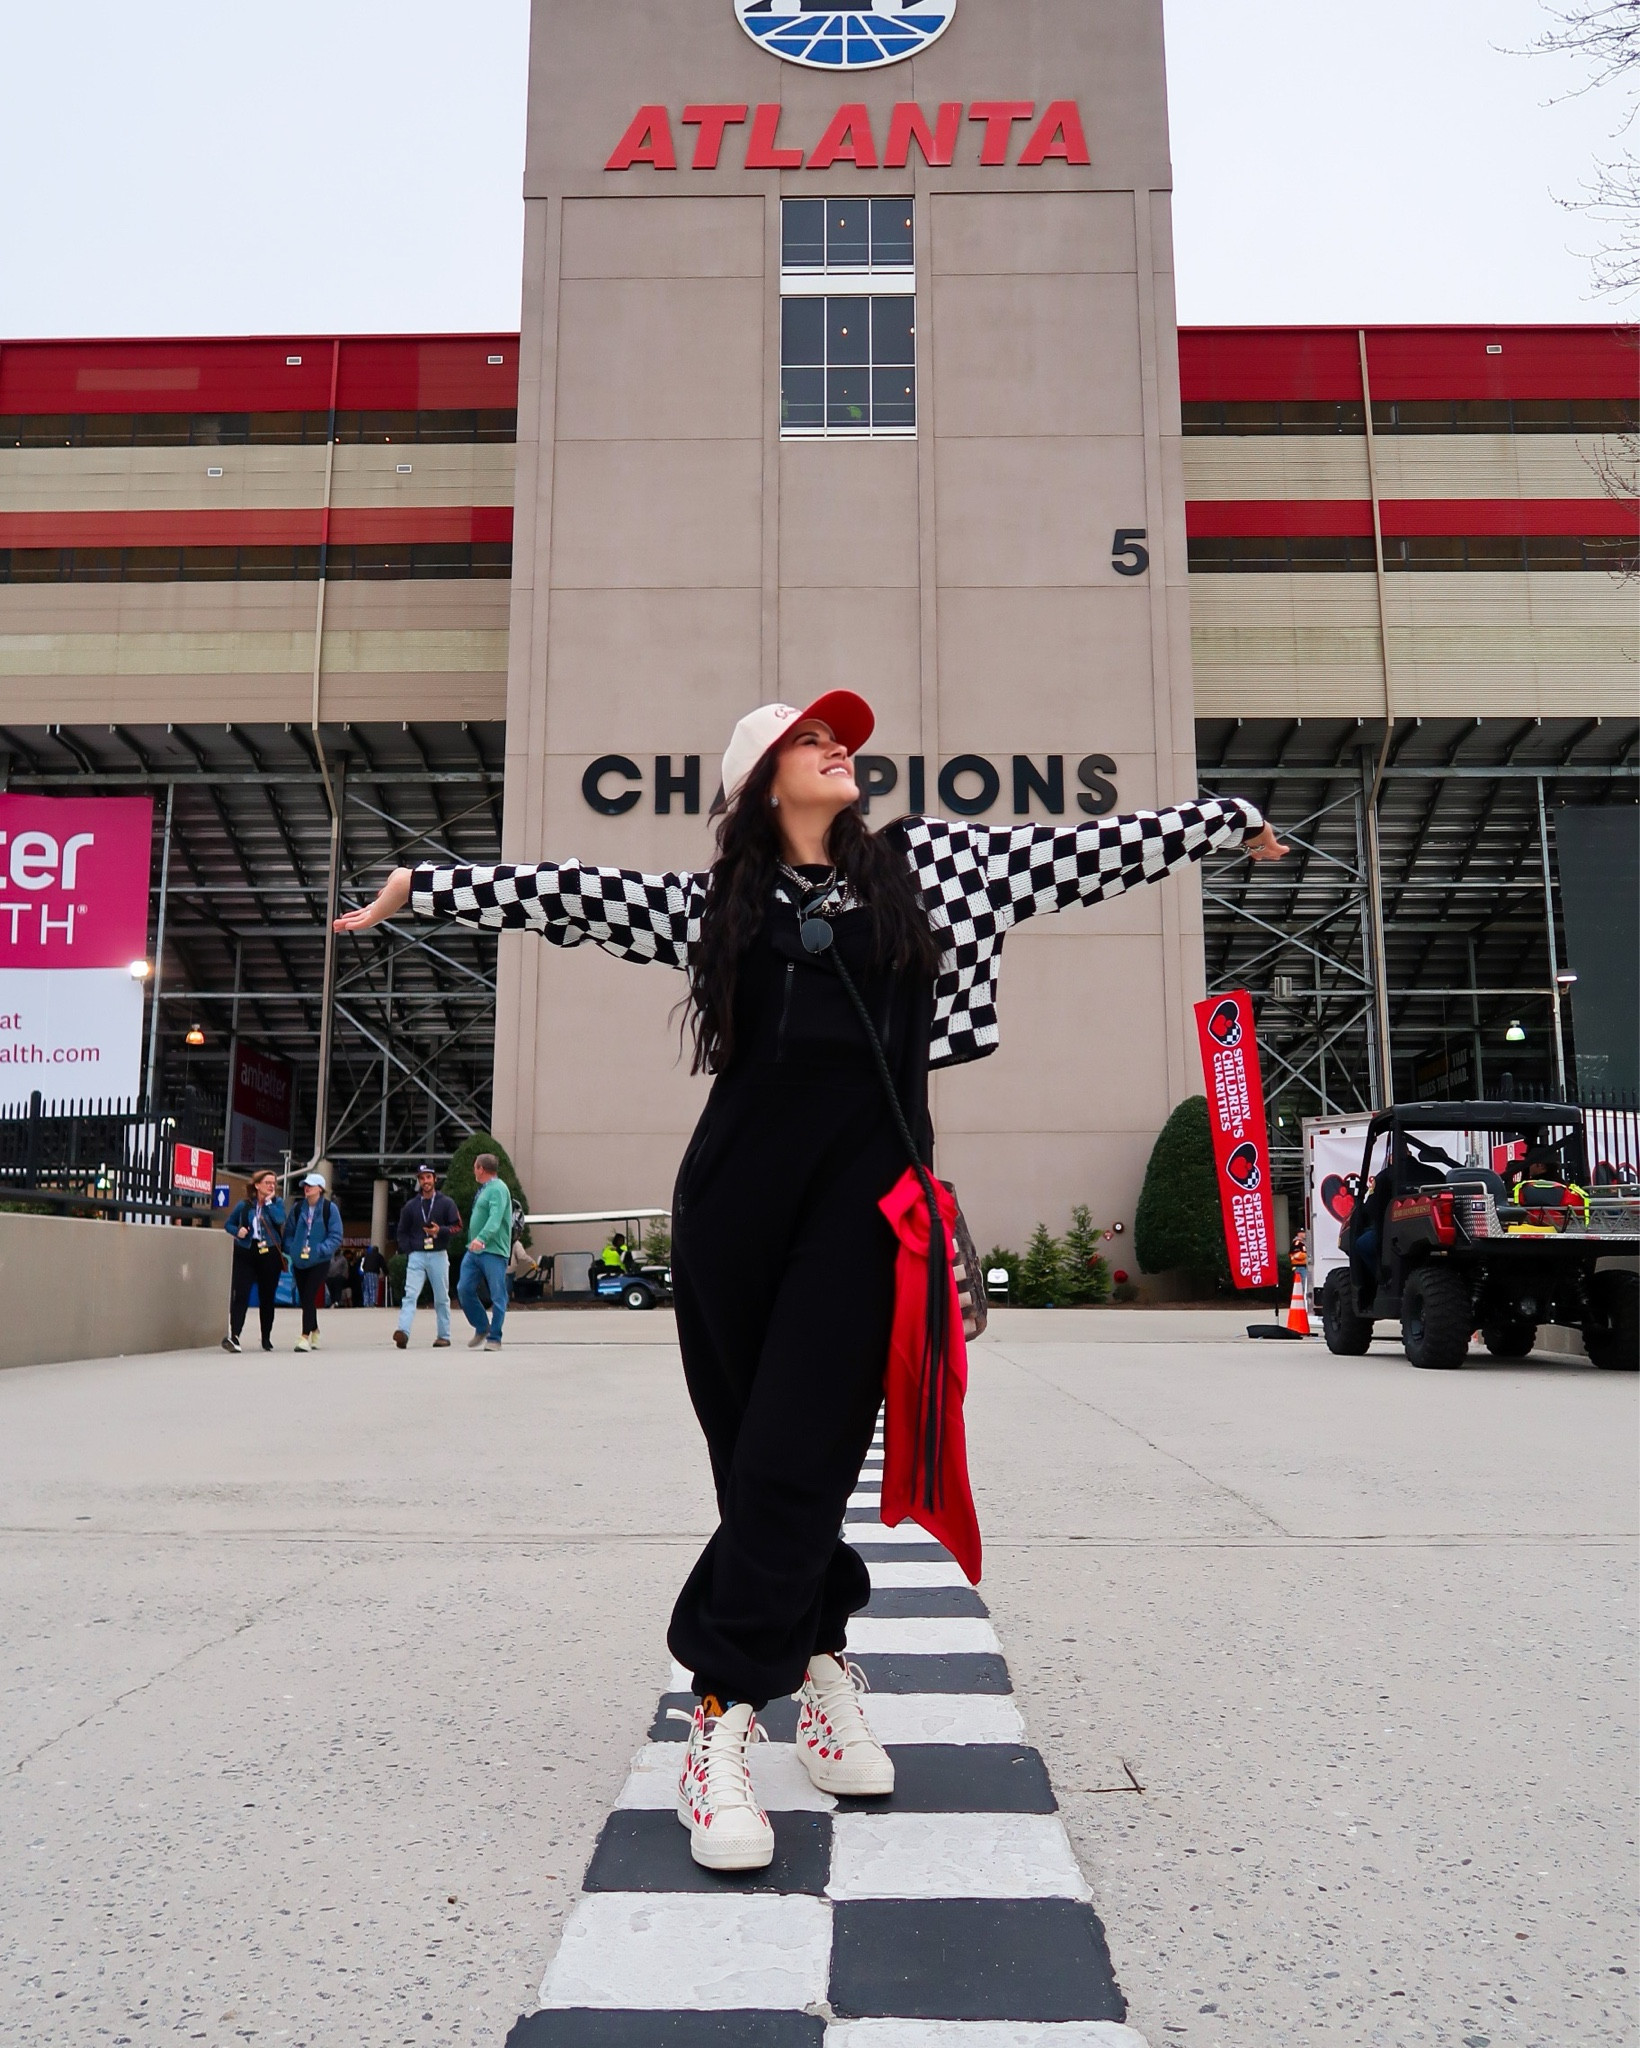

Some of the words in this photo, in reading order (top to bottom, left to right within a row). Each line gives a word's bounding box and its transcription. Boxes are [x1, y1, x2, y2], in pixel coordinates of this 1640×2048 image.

[603, 100, 1091, 171] ATLANTA
[1111, 528, 1149, 577] 5
[581, 753, 1118, 816] CHPIONS
[1213, 1052, 1231, 1132] CHARITIES
[1222, 1050, 1244, 1139] CHILDREN'S
[1233, 1047, 1251, 1120] SPEEDWAY
[174, 1173, 212, 1192] GRANDSTANDS
[1232, 1195, 1251, 1277] CHARITIES
[1243, 1193, 1262, 1285] CHILDREN'S
[1253, 1192, 1269, 1267] SPEEDWAY
